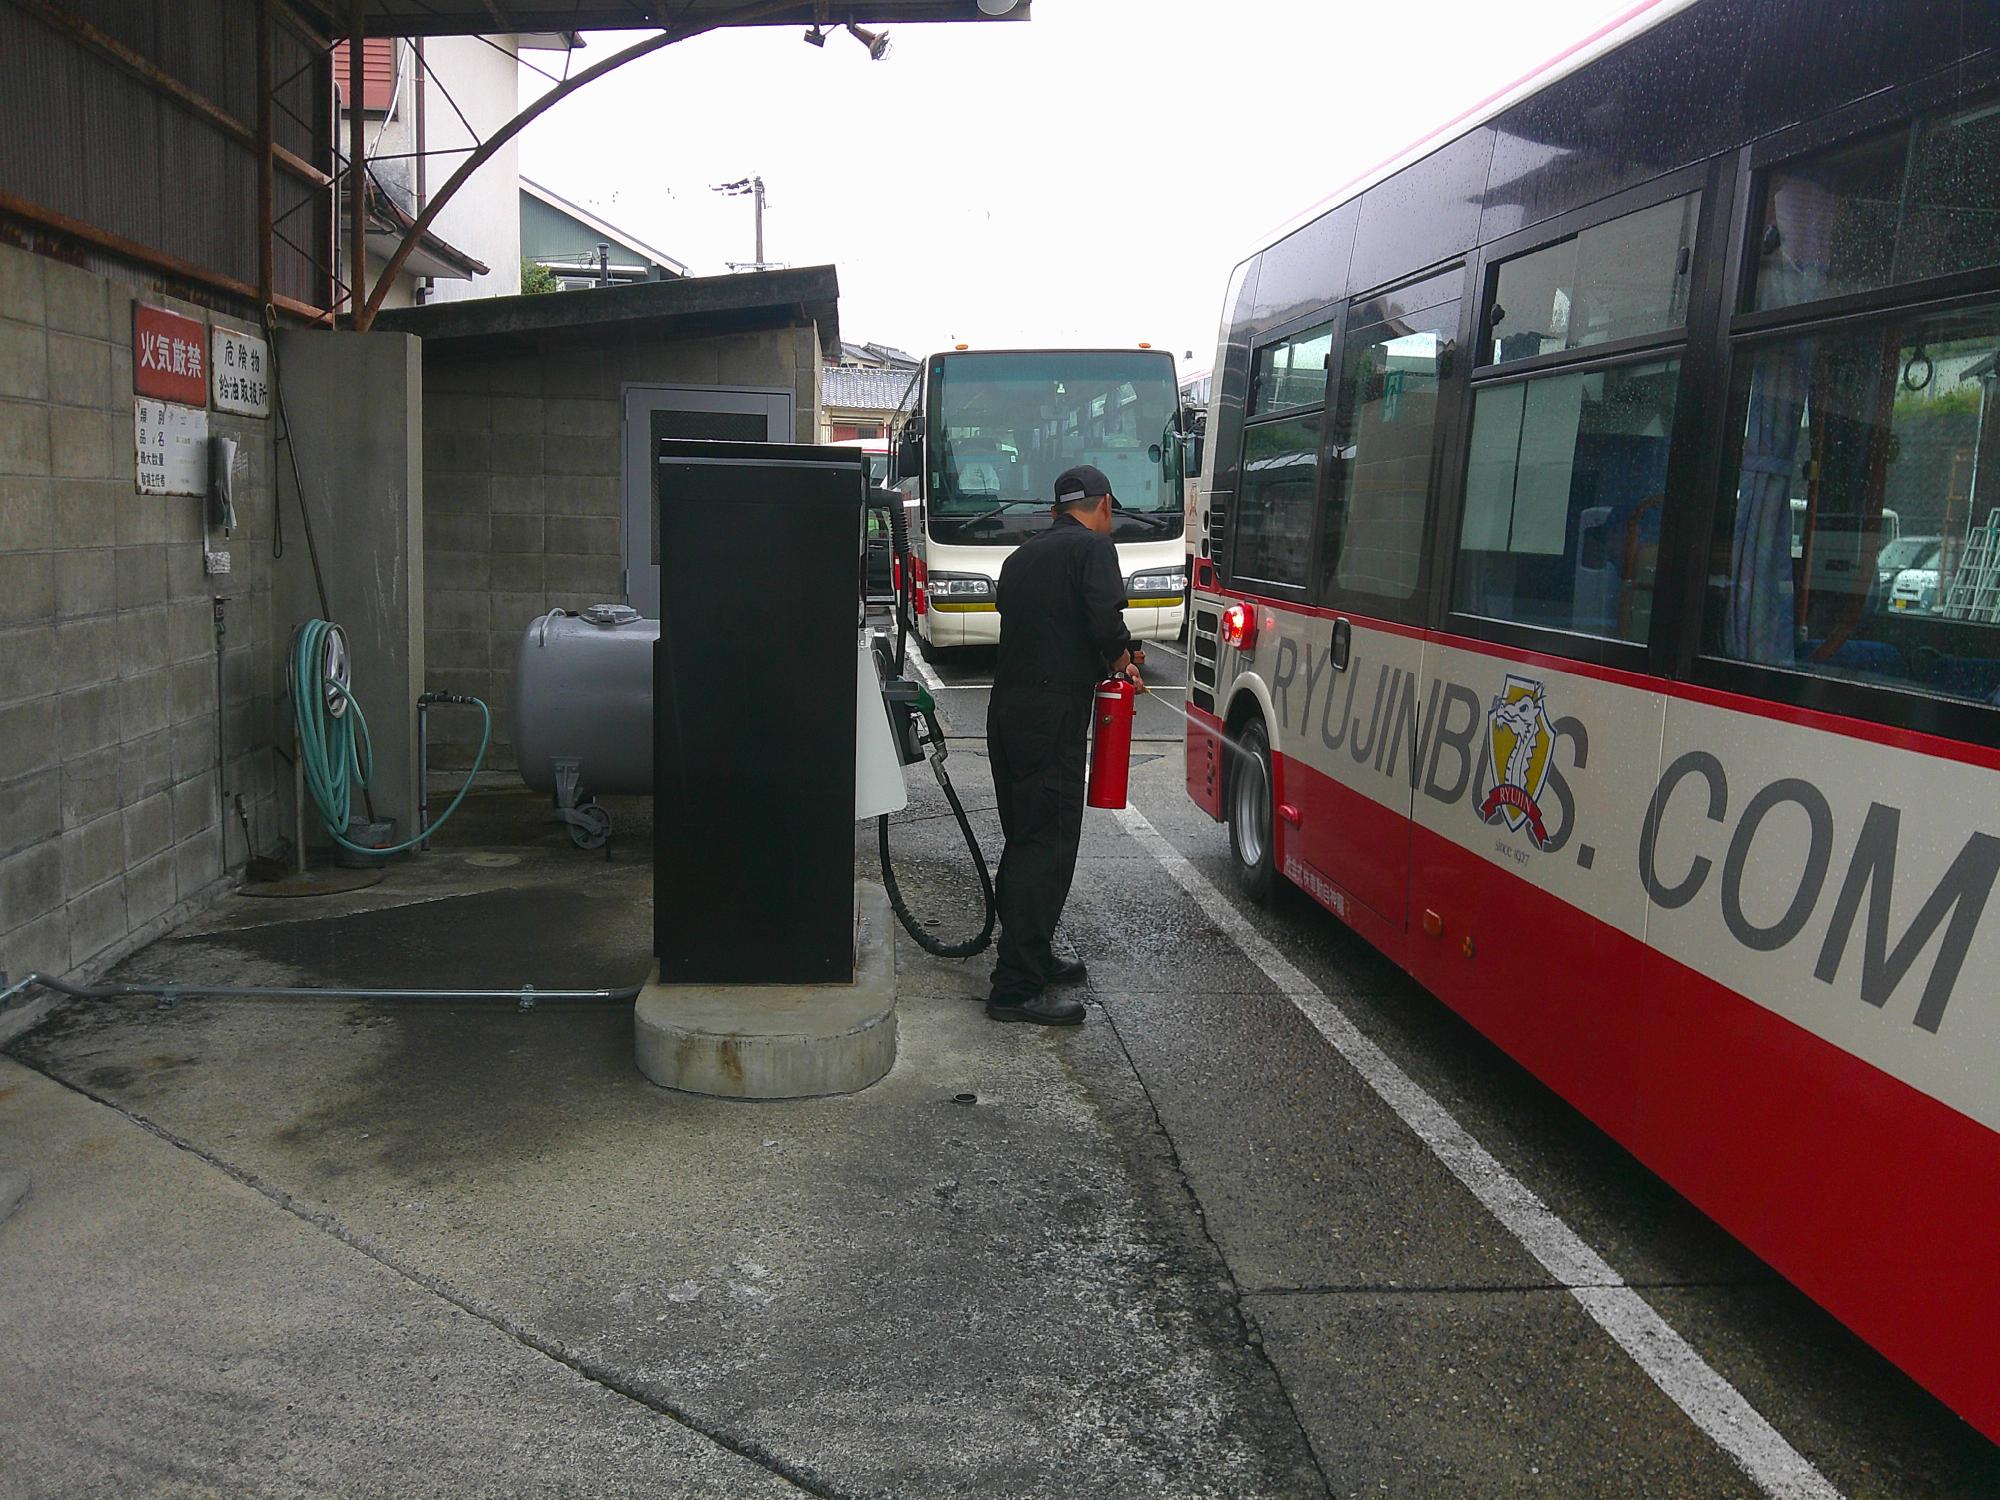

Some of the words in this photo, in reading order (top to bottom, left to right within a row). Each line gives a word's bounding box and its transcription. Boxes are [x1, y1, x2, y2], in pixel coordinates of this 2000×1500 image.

[140, 331, 202, 379] 火気厳禁
[223, 339, 260, 374] 危険物
[219, 374, 268, 407] 給油取扱所
[1499, 786, 1532, 813] RYUJIN
